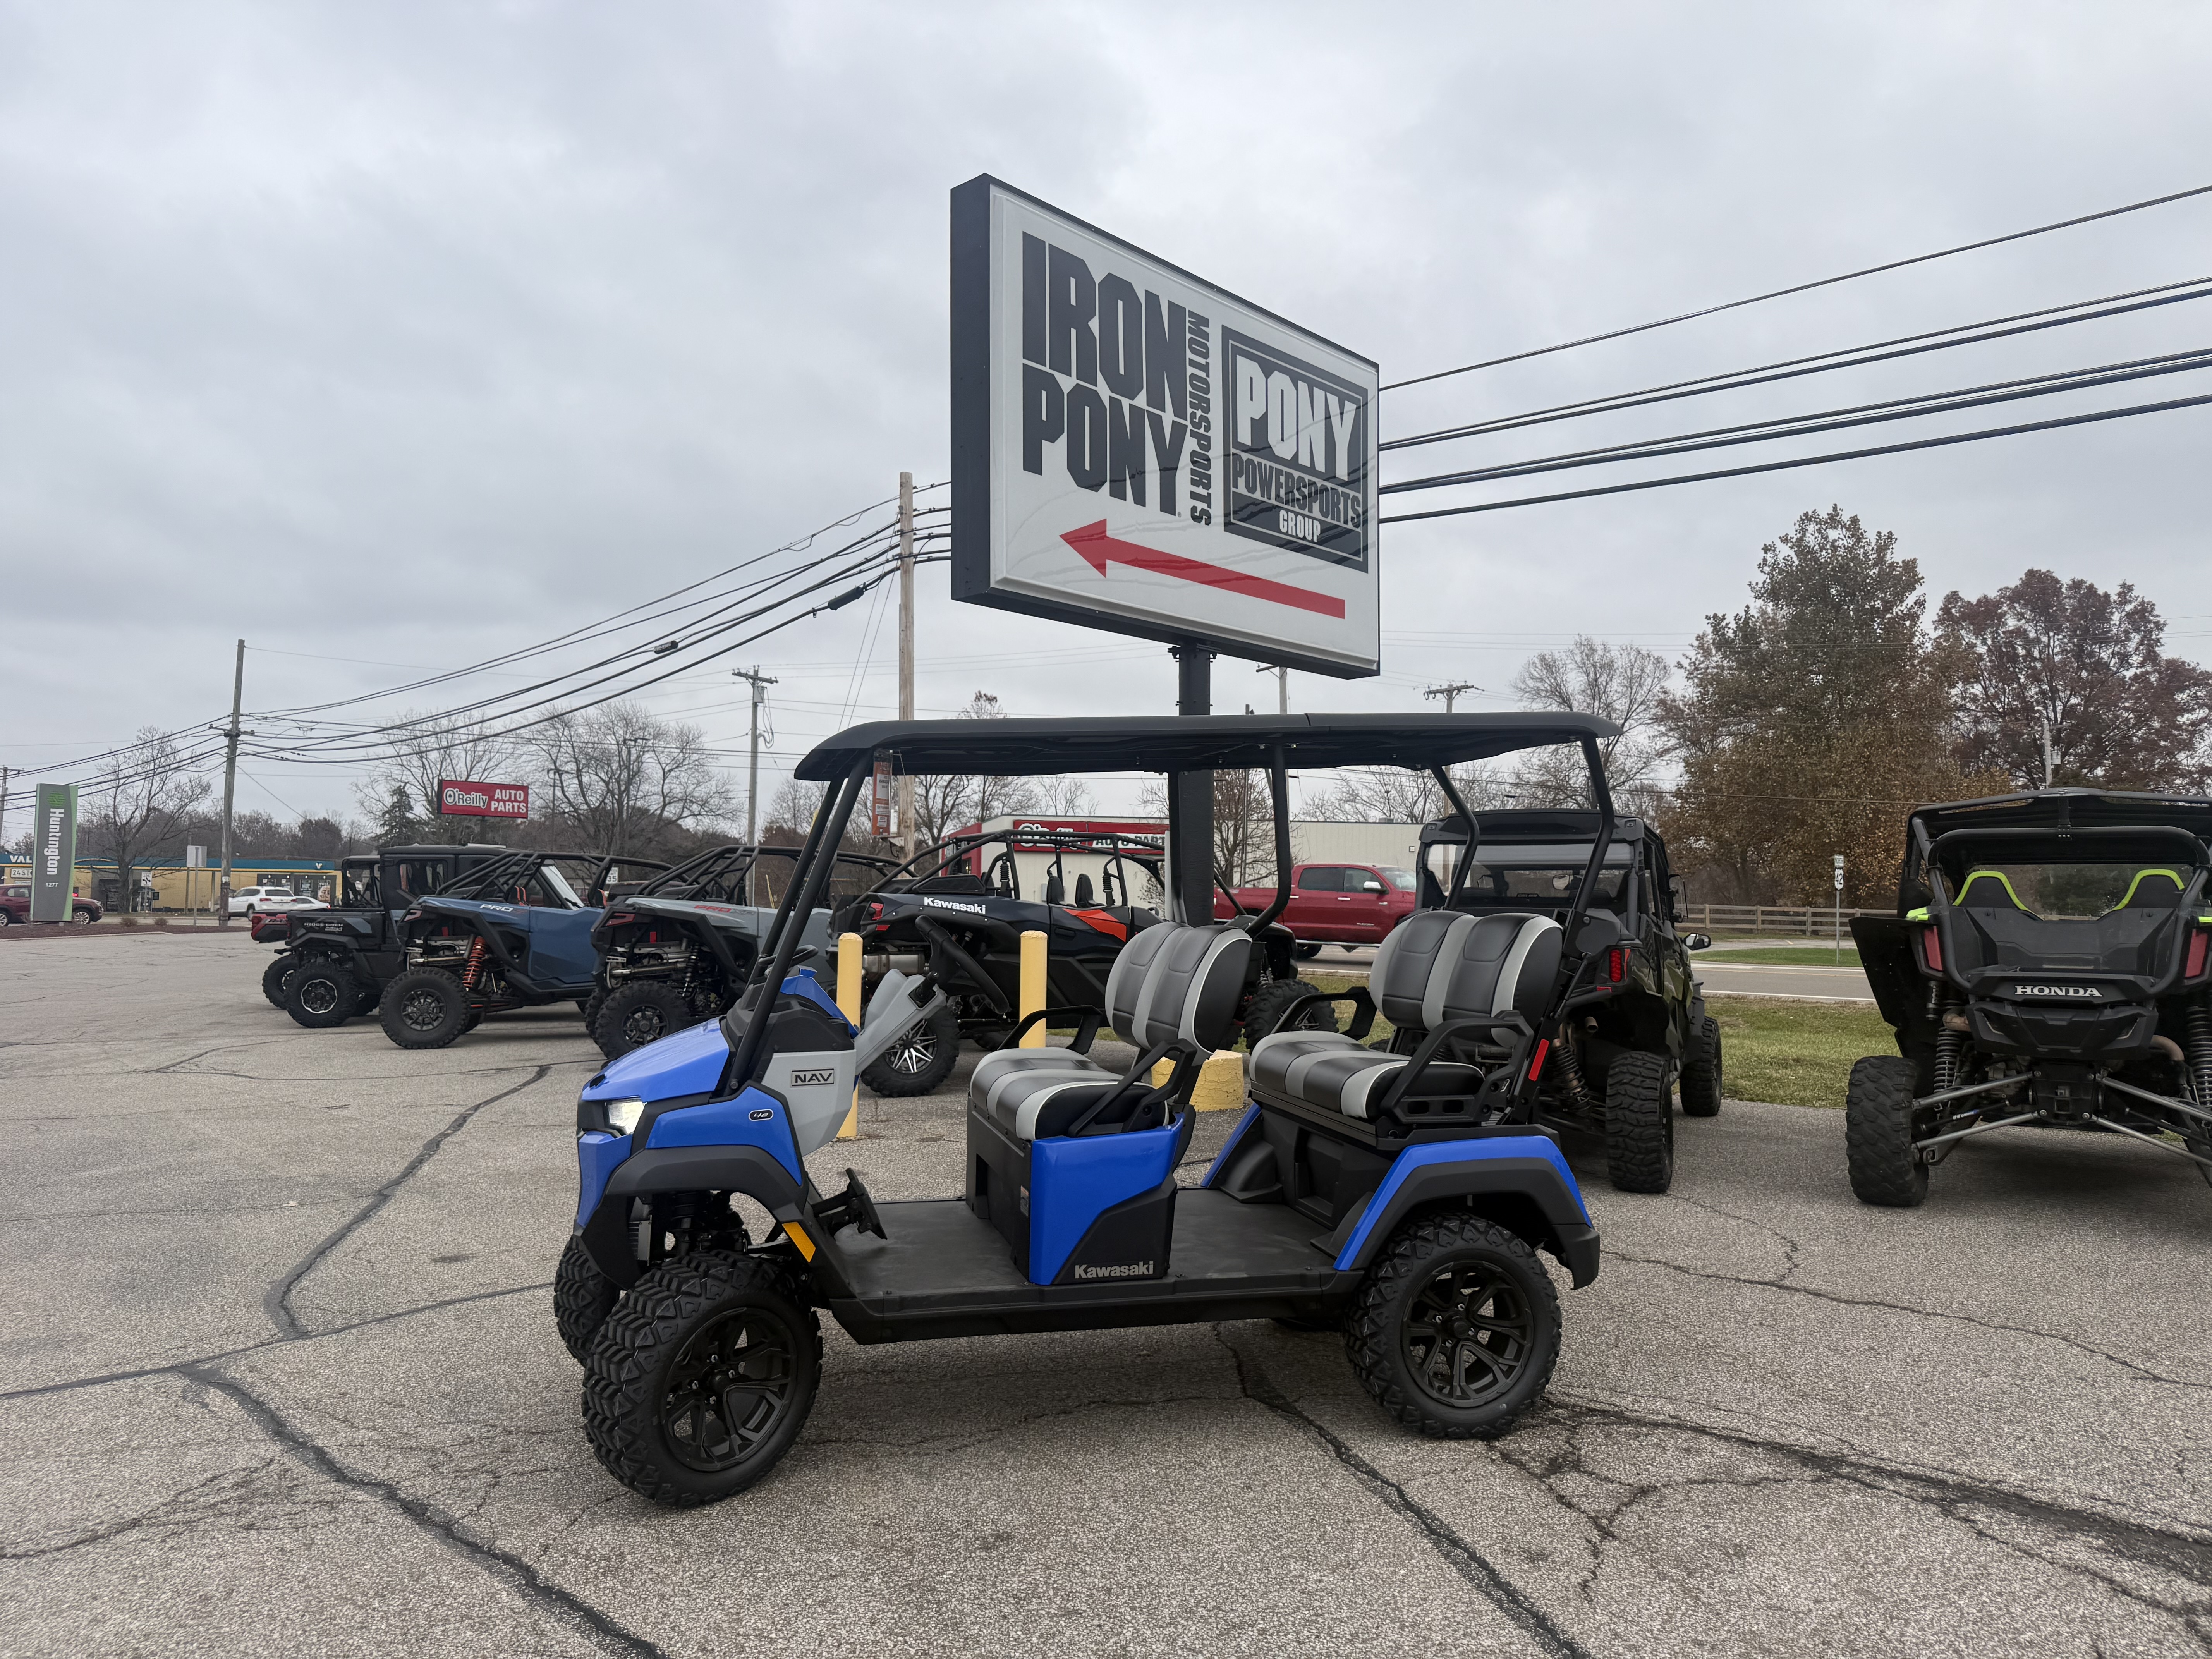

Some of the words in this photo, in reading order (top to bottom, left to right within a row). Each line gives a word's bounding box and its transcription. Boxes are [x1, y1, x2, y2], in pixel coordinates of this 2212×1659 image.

[1022, 231, 1187, 421] IRON
[1188, 309, 1212, 526] MOTORSPORTS
[1236, 354, 1357, 481] PONY
[1022, 362, 1188, 516] PONY
[1232, 452, 1361, 529] POWERSPORTS
[1279, 509, 1321, 542] GROUP
[444, 788, 488, 808] O'Reilly
[495, 789, 524, 801] AUTO
[491, 801, 526, 813] PARTS
[44, 808, 64, 875] Huntington
[10, 855, 32, 863] VAL
[1836, 873, 1843, 885] 42
[694, 905, 732, 913] PRO
[924, 897, 986, 914] Kawasaki
[2014, 986, 2103, 997] HONDA
[795, 1072, 833, 1083] NAV
[1075, 1261, 1154, 1279] Kawasaki
